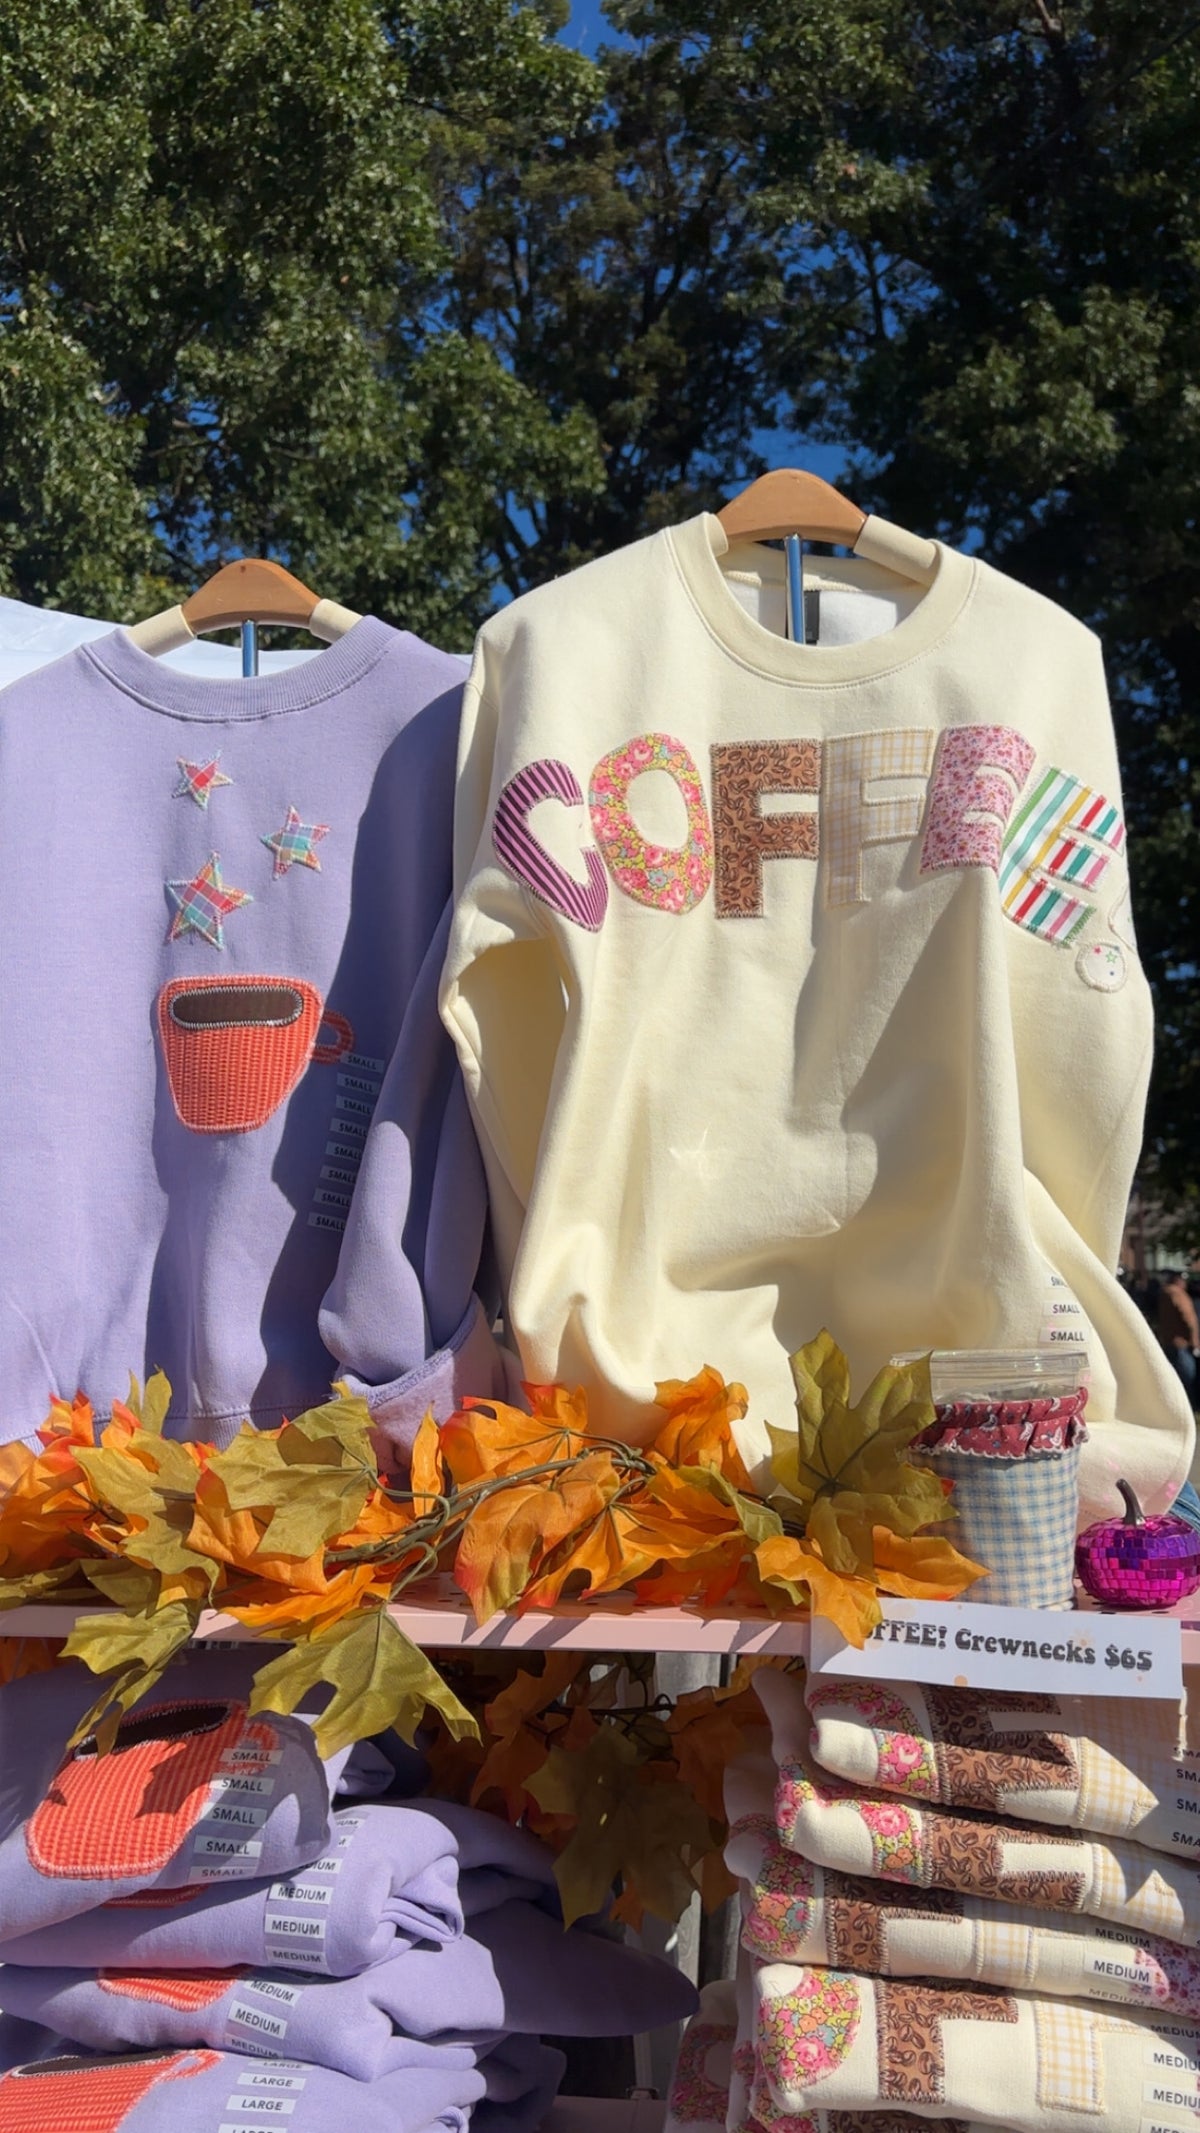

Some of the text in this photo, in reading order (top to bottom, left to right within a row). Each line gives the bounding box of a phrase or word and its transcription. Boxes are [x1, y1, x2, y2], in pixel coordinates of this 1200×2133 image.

[348, 1055, 376, 1070] SMALL
[344, 1077, 373, 1092] SMALL
[344, 1100, 371, 1115] SMALL
[339, 1123, 367, 1137] SMALL
[321, 1193, 350, 1207] SMALL
[316, 1216, 345, 1231] SMALL
[1052, 1304, 1080, 1314] SMALL
[1050, 1331, 1085, 1341] SMALL
[866, 1618, 1153, 1672] FFEE! Crewnecks $65
[231, 1751, 271, 1762] SMALL
[221, 1777, 263, 1792] SMALL
[212, 1807, 255, 1824] SMALL
[206, 1841, 250, 1855] SMALL
[201, 1868, 243, 1877] SMALL
[278, 1886, 327, 1901] MEDIUM
[271, 1920, 320, 1935] MEDIUM
[1095, 1927, 1151, 1948] MEDIUM
[273, 1951, 321, 1964] MEDIUM
[1094, 1960, 1150, 1982] MEDIUM
[251, 1980, 294, 2001] MEDIUM
[235, 2008, 281, 2035] MEDIUM
[231, 2038, 279, 2059] MEDIUM
[1153, 2052, 1200, 2071] MEDIU
[252, 2076, 294, 2087] LARGE
[241, 2099, 283, 2111] LARGE
[1153, 2089, 1200, 2109] MEDIU
